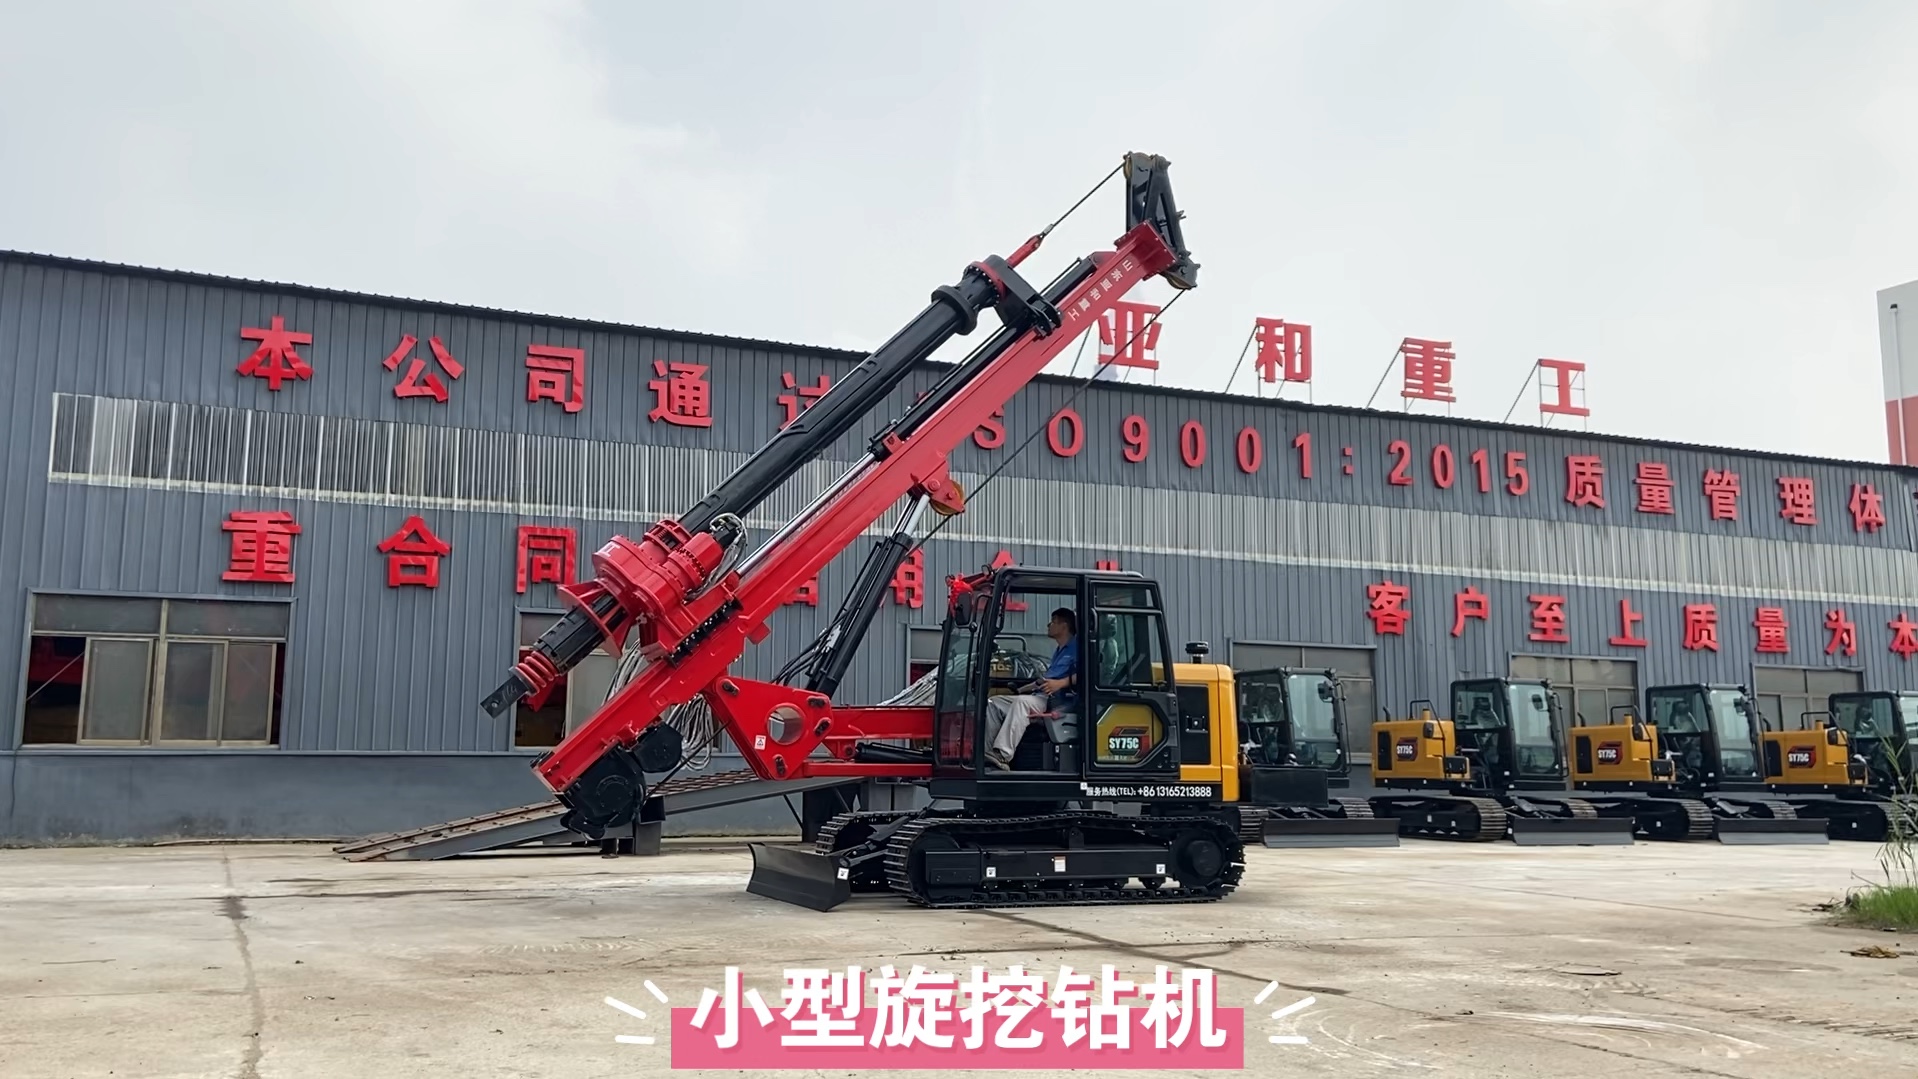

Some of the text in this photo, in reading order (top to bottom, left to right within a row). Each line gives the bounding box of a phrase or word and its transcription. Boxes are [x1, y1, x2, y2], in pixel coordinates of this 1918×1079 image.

[1098, 301, 1590, 417] 亚和重工
[1109, 737, 1140, 749] SY75C
